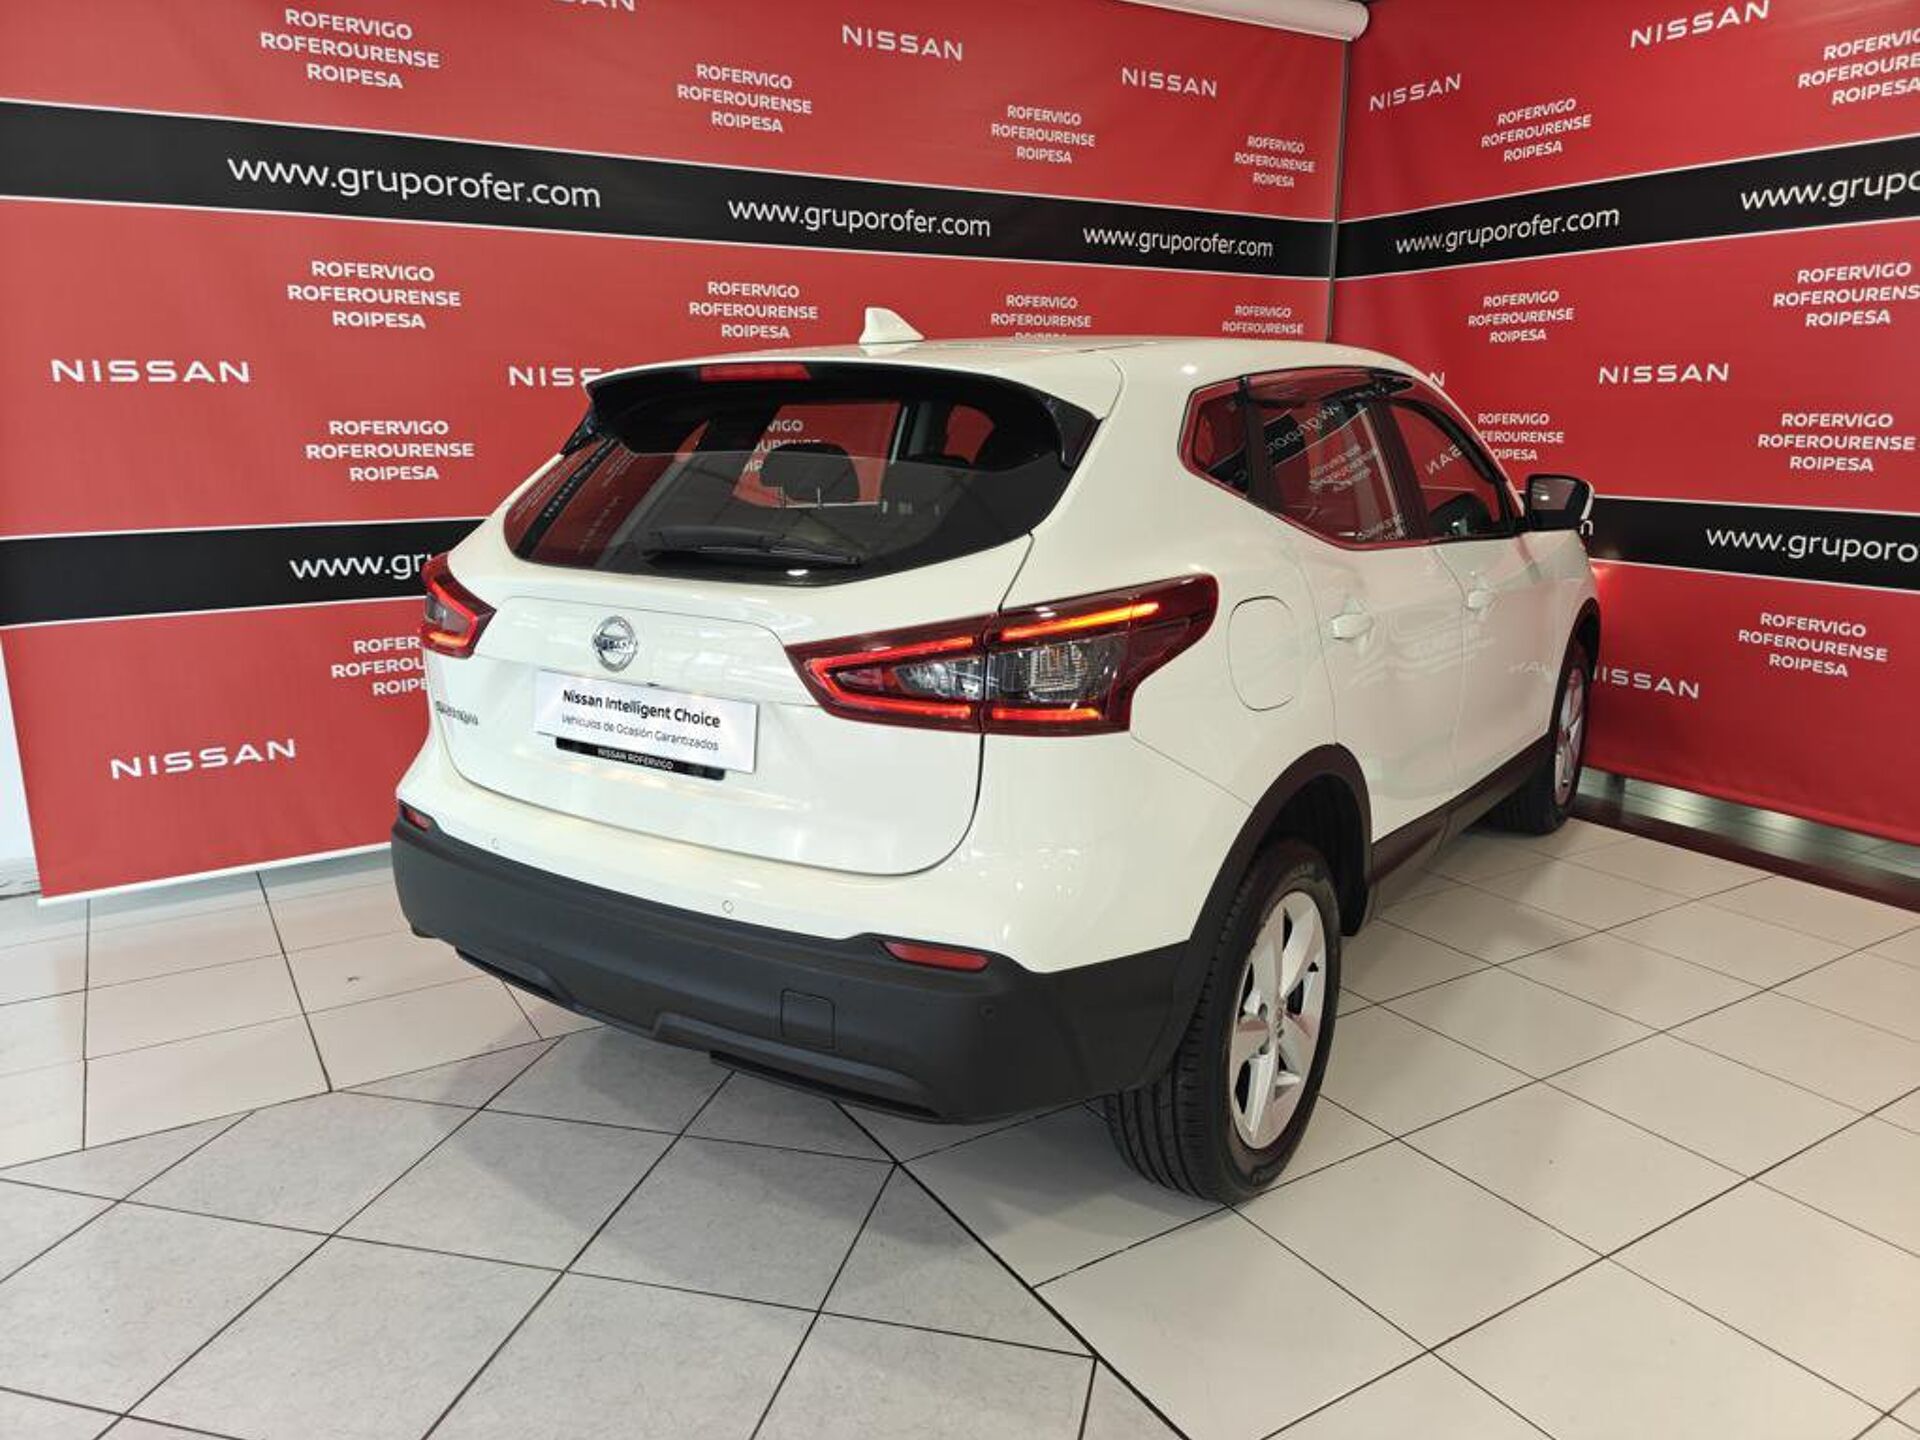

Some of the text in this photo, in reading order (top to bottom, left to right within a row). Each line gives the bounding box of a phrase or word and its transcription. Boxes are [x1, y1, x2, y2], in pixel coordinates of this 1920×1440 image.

[284, 8, 412, 41] ROFERVIGO
[1630, 1, 1770, 49] NISSAN
[259, 31, 440, 69] ROFEROURENSE
[842, 24, 963, 61] NISSAN
[306, 63, 403, 89] ROIPESA
[696, 63, 792, 89] ROFERVIGO
[1121, 67, 1217, 97] NISSAN
[677, 85, 812, 114] ROFEROURENSE
[1370, 74, 1462, 112] NISSAN
[1831, 77, 1920, 105] ROIPESA
[711, 111, 783, 132] ROIPESA
[1007, 104, 1081, 126] ROFERVIGO
[1498, 98, 1576, 125] ROFERVIGO
[991, 122, 1096, 146] ROFEROURENSE
[1481, 115, 1592, 147] ROFEROURENSE
[1016, 145, 1072, 163] ROIPESA
[1247, 135, 1305, 153] ROFERVIGO
[1503, 142, 1563, 162] ROIPESA
[1234, 151, 1315, 172] ROFEROURENSE
[227, 157, 601, 208] www.gruporofer.com
[1252, 171, 1294, 187] ROIPESA
[728, 200, 990, 237] www.gruporofer.com
[1083, 225, 1273, 257] www.gruporofer.com
[1396, 208, 1620, 255] www.gruporofer.com
[311, 260, 435, 282] ROFERVIGO
[1797, 262, 1911, 283] ROFERVIGO
[287, 284, 461, 306] ROFEROURENSE
[707, 281, 800, 298] ROFERVIGO
[1483, 291, 1560, 308] ROFERVIGO
[689, 301, 818, 318] ROFEROURENSE
[1006, 295, 1078, 309] ROFERVIGO
[1235, 305, 1291, 318] ROFERVIGO
[332, 310, 426, 329] ROIPESA
[991, 312, 1091, 328] ROFEROURENSE
[1222, 320, 1304, 334] ROFEROURENSE
[1468, 307, 1574, 327] ROFEROURENSE
[1805, 309, 1890, 327] ROIPESA
[721, 323, 790, 339] ROIPESA
[1489, 330, 1546, 343] ROIPESA
[50, 359, 250, 383] NISSAN
[1599, 363, 1729, 385] NISSAN
[328, 420, 449, 436] ROFERVIGO
[1477, 413, 1550, 425] ROFERVIGO
[1781, 413, 1893, 429] ROFERVIGO
[1482, 431, 1564, 444] FEROURENSE
[1757, 434, 1915, 451] ROFEROURENSE
[305, 442, 474, 458] ROFEROURENSE
[1493, 449, 1538, 461] OIPESA
[349, 465, 439, 481] ROIPESA
[1790, 455, 1874, 472] ROIPESA
[290, 553, 432, 580] www.gr
[1760, 612, 1866, 637] ROFERVIGO
[1739, 629, 1888, 662] ROFEROURENSE
[1769, 653, 1848, 677] ROIPESA
[563, 689, 720, 728] Nissan Intelligent Choice
[604, 721, 614, 732] de
[655, 730, 719, 751] Garantizados
[111, 738, 296, 779] NISSAN
